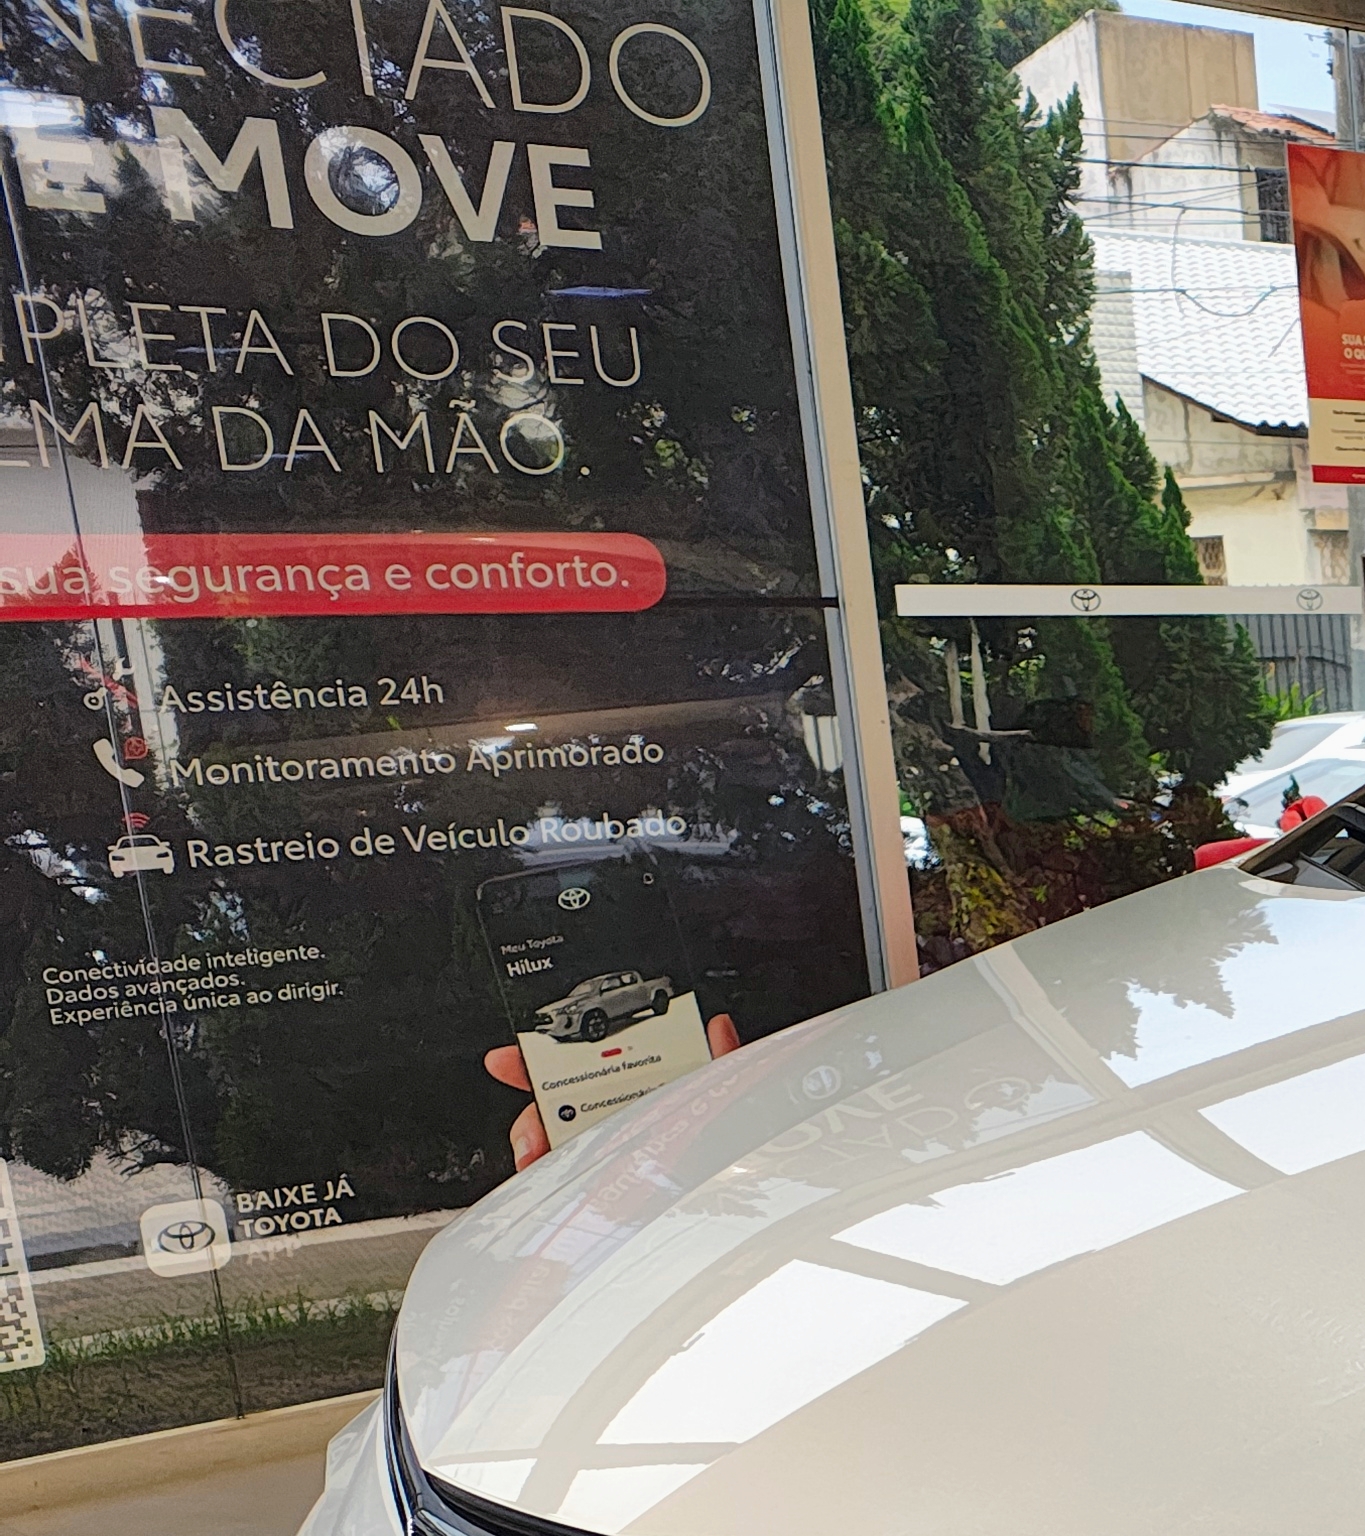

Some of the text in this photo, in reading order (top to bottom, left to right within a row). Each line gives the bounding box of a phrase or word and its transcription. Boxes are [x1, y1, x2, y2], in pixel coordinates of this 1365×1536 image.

[150, 104, 604, 251] MOVE
[0, 294, 643, 388] PLETA DO SEU
[1341, 333, 1363, 346] SUA
[1344, 348, 1352, 359] O
[212, 405, 342, 473] DA
[369, 401, 592, 477] MÃO.
[0, 551, 631, 604] sua segurança e conforto.
[160, 676, 445, 715] Assistência 24h
[168, 738, 665, 787] Monitoramento Aprimorado
[187, 809, 688, 868] Rastreio de Veículo Roubado
[42, 944, 326, 986] Conectividade inteligente.
[500, 934, 565, 956] Meu Toyota
[506, 956, 554, 978] Hilux
[46, 970, 246, 1006] Dados avançados.
[50, 979, 345, 1027] Experiência única ao dirigir.
[236, 1173, 356, 1214] BAIXE JÁ
[238, 1206, 343, 1239] TOYOTA
[246, 1236, 304, 1266] APP
